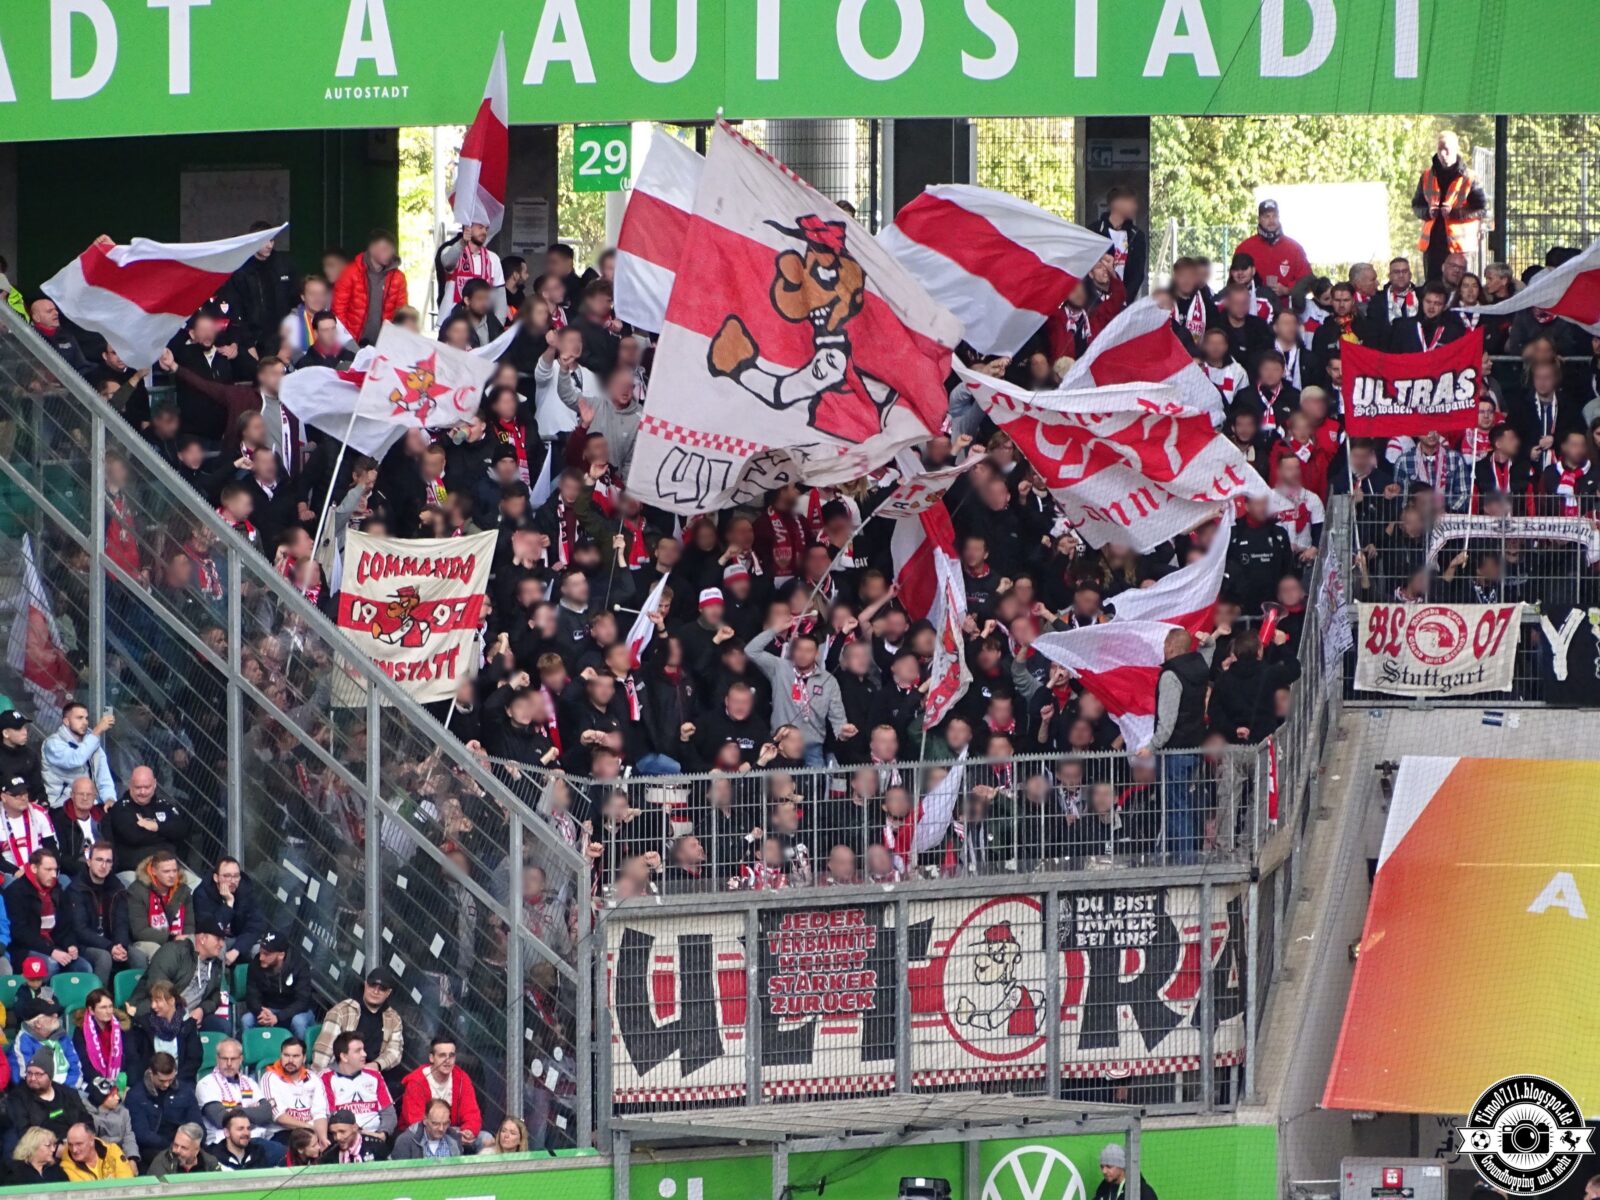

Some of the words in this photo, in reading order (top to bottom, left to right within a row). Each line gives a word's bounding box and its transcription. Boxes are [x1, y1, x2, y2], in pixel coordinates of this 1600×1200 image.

[324, 86, 409, 99] AUTOSTADT
[579, 140, 627, 175] 29
[1352, 369, 1477, 409] ULTRAS
[356, 551, 476, 585] COMMANDO
[351, 599, 378, 625] 19
[1375, 659, 1485, 693] Stuttgart
[1076, 896, 1105, 913] DU
[1113, 894, 1158, 912] BIST
[1526, 871, 1589, 920] A
[779, 908, 866, 931] JEDER
[1076, 912, 1158, 932] IMMER
[767, 924, 878, 955] VERBANNTE
[1076, 933, 1106, 947] BEI
[778, 950, 869, 974] KEHRT
[1436, 1117, 1459, 1128] WC
